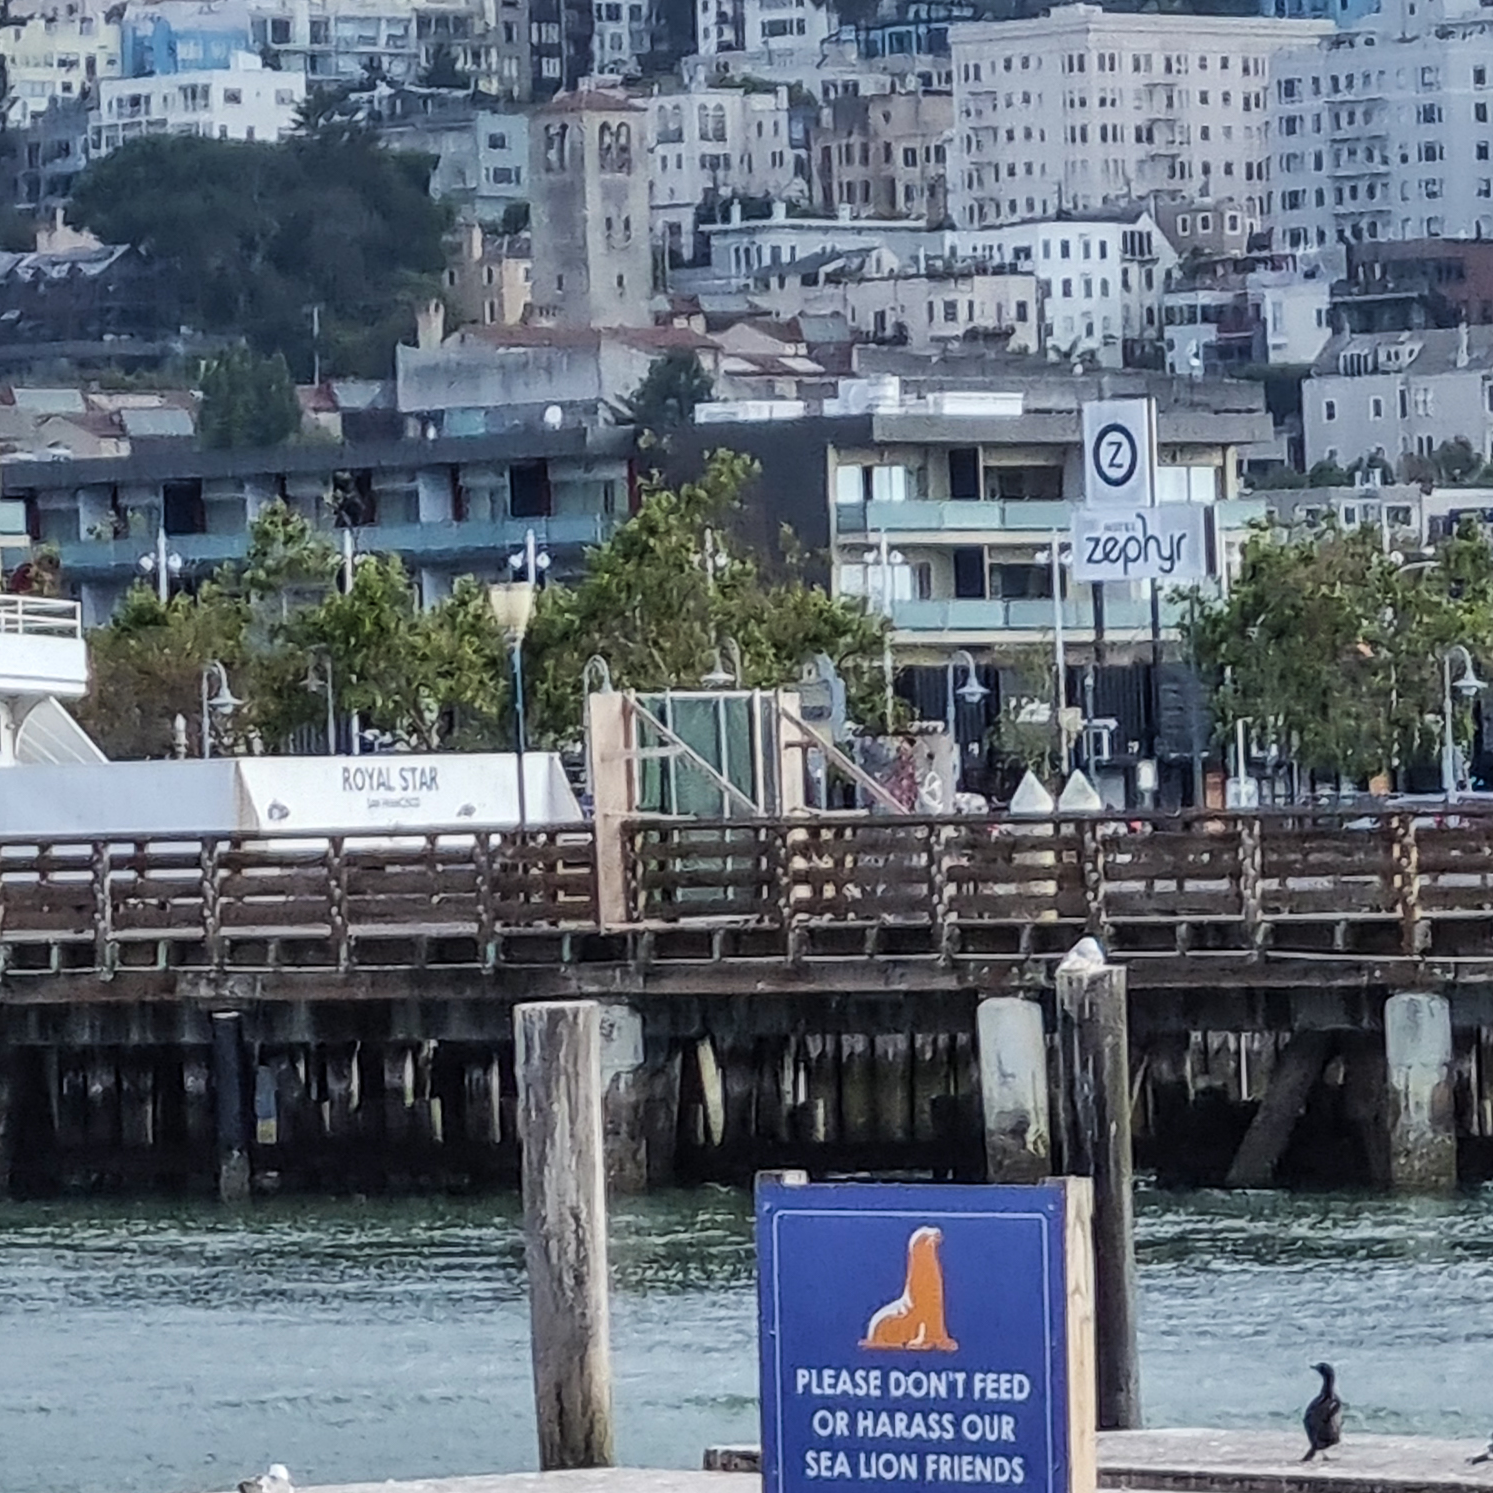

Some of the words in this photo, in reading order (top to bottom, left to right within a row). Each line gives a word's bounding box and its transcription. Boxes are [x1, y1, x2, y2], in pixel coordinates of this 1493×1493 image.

[1085, 513, 1187, 576] zephyr
[341, 766, 396, 792] ROYAL
[399, 766, 439, 792] STAR
[796, 1367, 882, 1398] PLEASE
[889, 1369, 965, 1400] DON'T
[973, 1371, 1031, 1402] FEED
[813, 1410, 850, 1438] OR
[857, 1410, 955, 1441] HARASS
[961, 1412, 1016, 1443] OUR
[805, 1449, 851, 1479] SEA
[859, 1451, 919, 1482] LION
[926, 1453, 1026, 1485] FRIENDS
